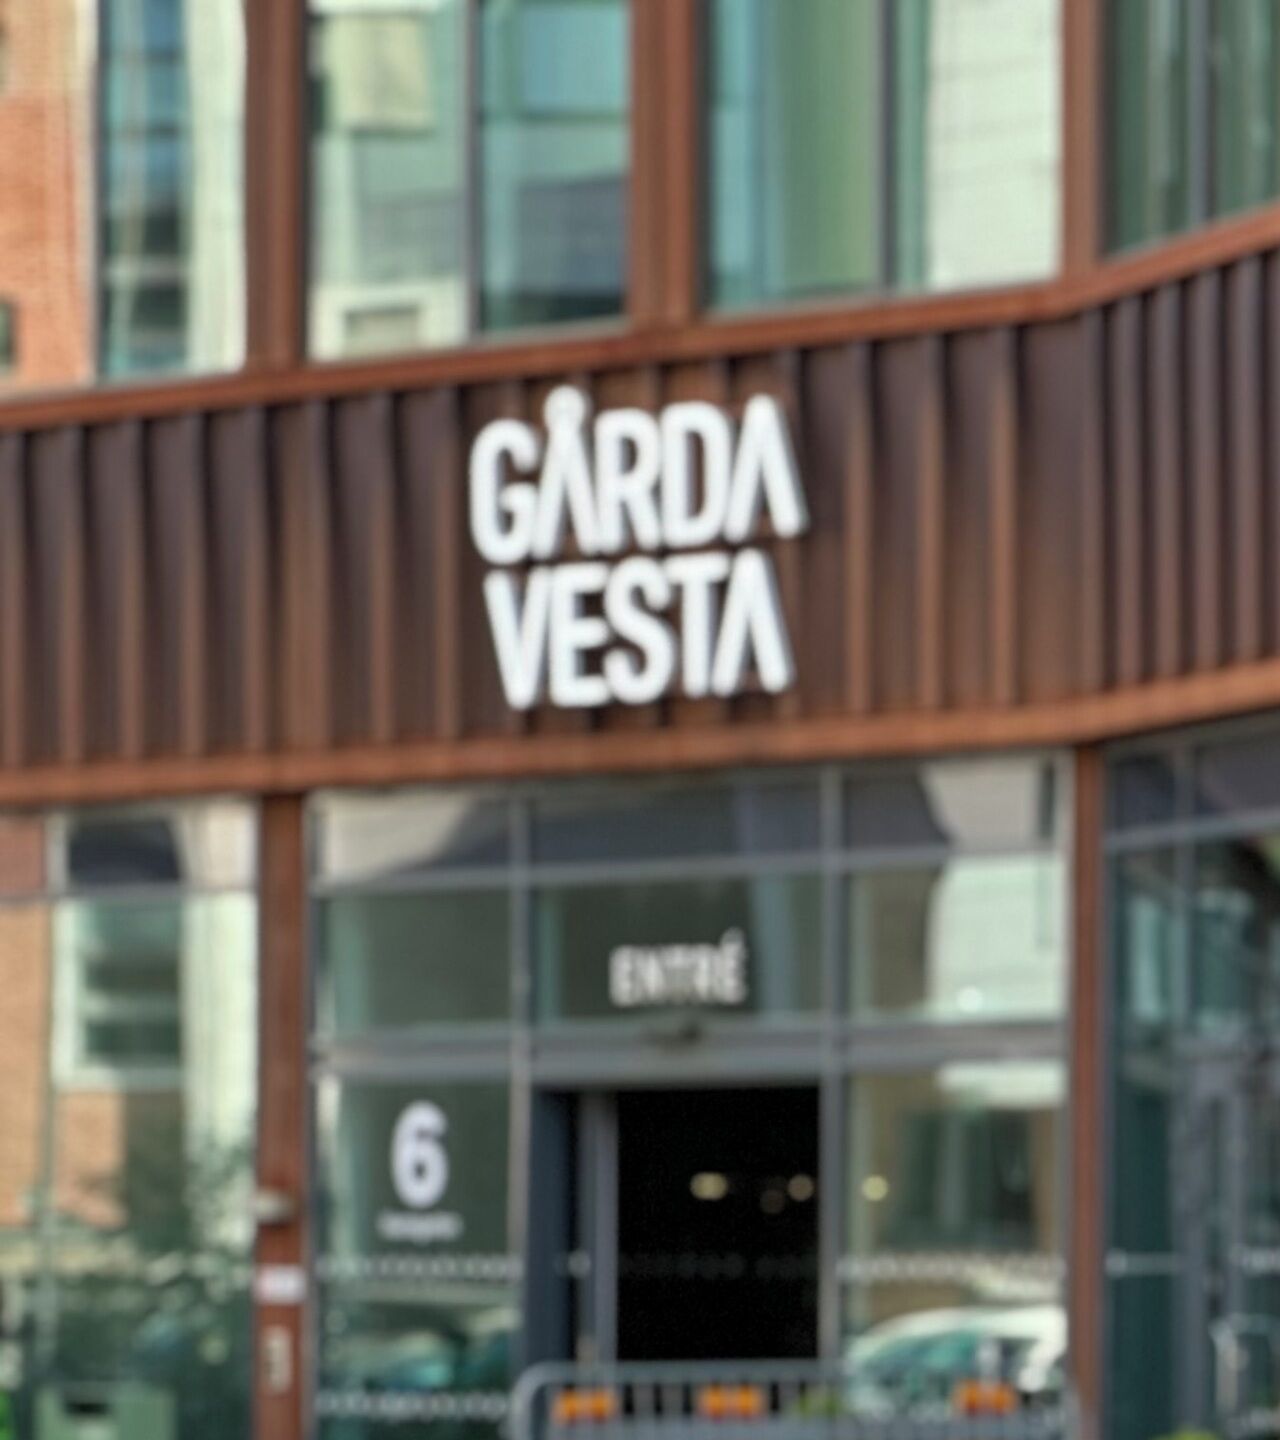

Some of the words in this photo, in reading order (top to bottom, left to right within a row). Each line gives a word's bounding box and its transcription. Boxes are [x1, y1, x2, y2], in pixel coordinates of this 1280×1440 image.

[469, 387, 808, 564] GÅRDA
[484, 549, 793, 710] VESTA
[609, 929, 747, 1007] ENTRÉ
[391, 1100, 449, 1208] 6
